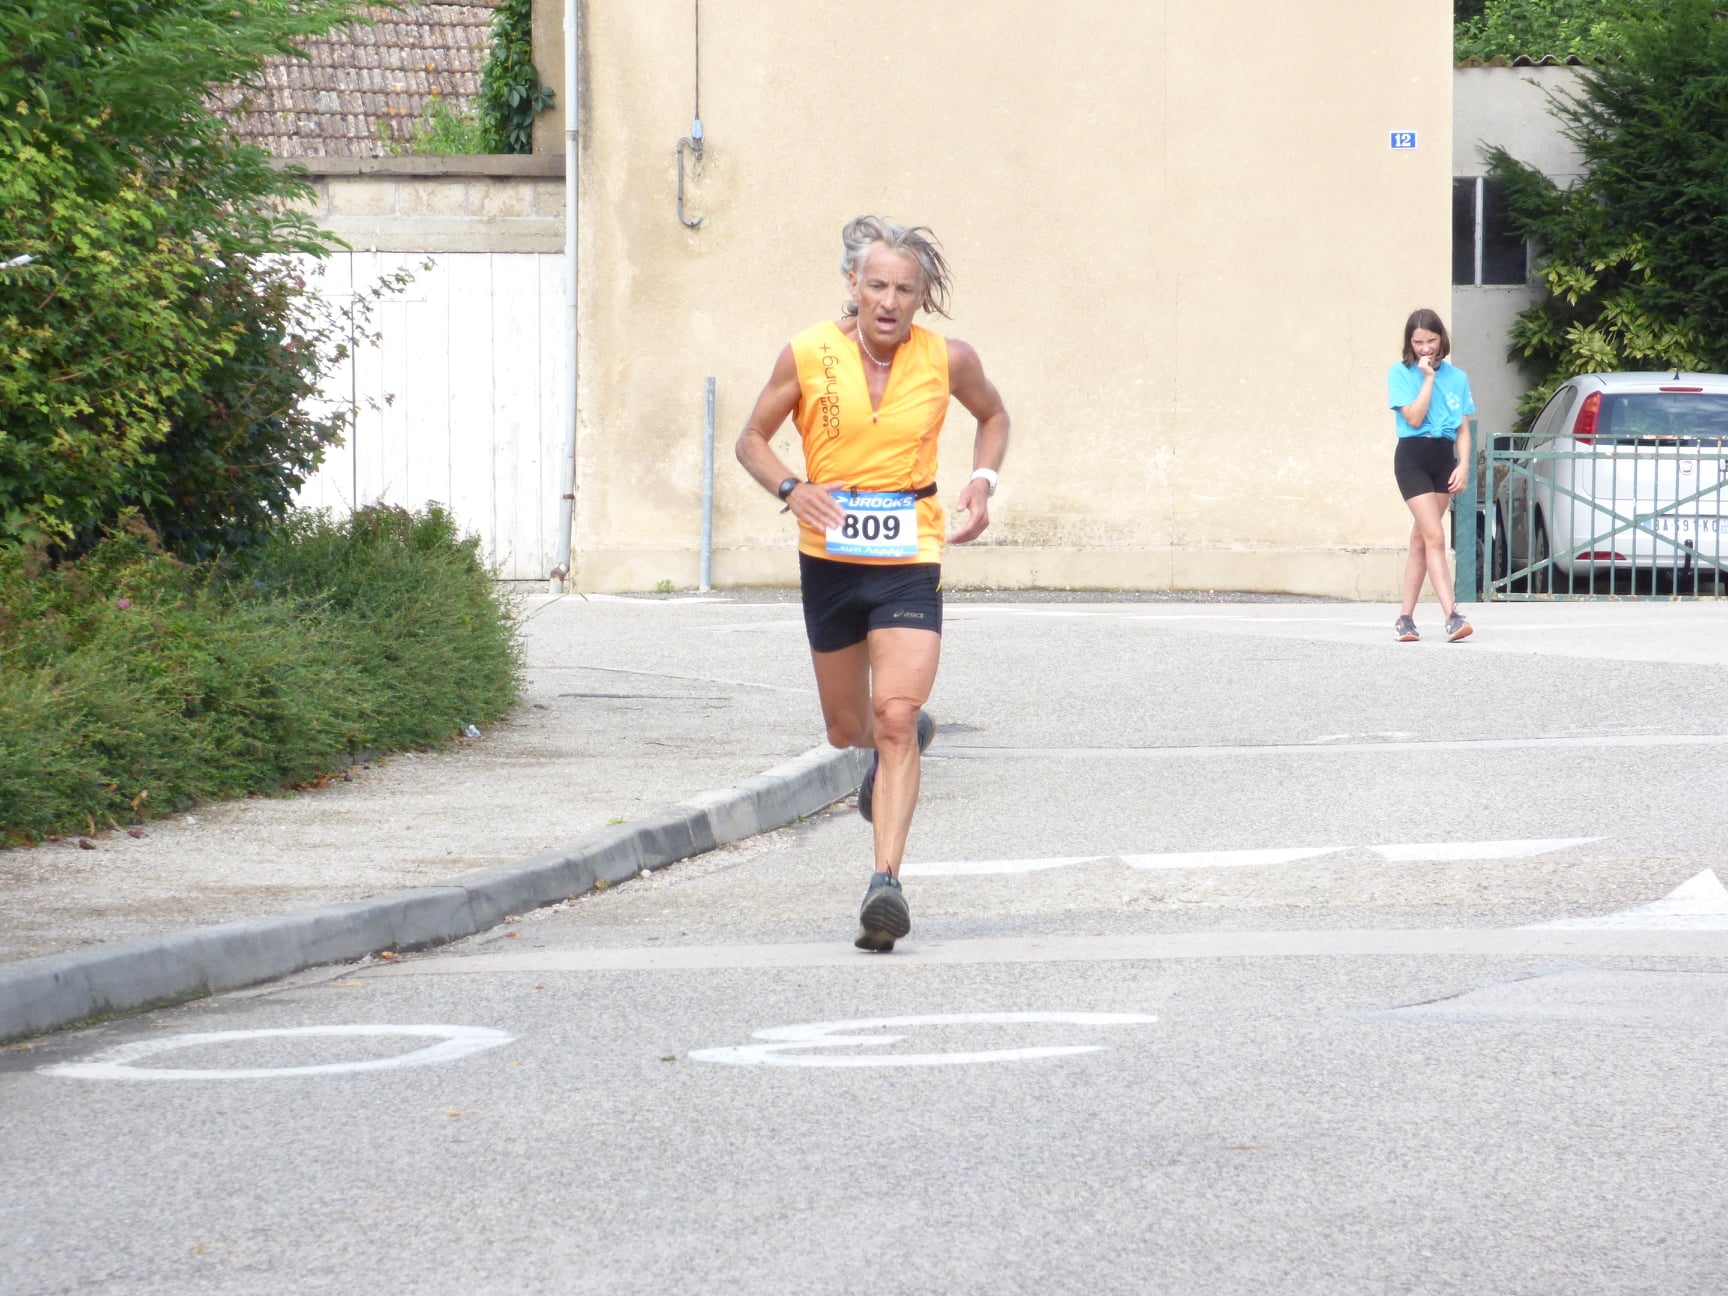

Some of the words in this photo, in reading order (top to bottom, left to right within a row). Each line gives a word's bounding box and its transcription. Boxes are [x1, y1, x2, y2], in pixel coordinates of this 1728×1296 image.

[1395, 133, 1412, 147] 12
[820, 396, 829, 427] team
[848, 496, 912, 508] BROOKS
[841, 513, 901, 541] 809
